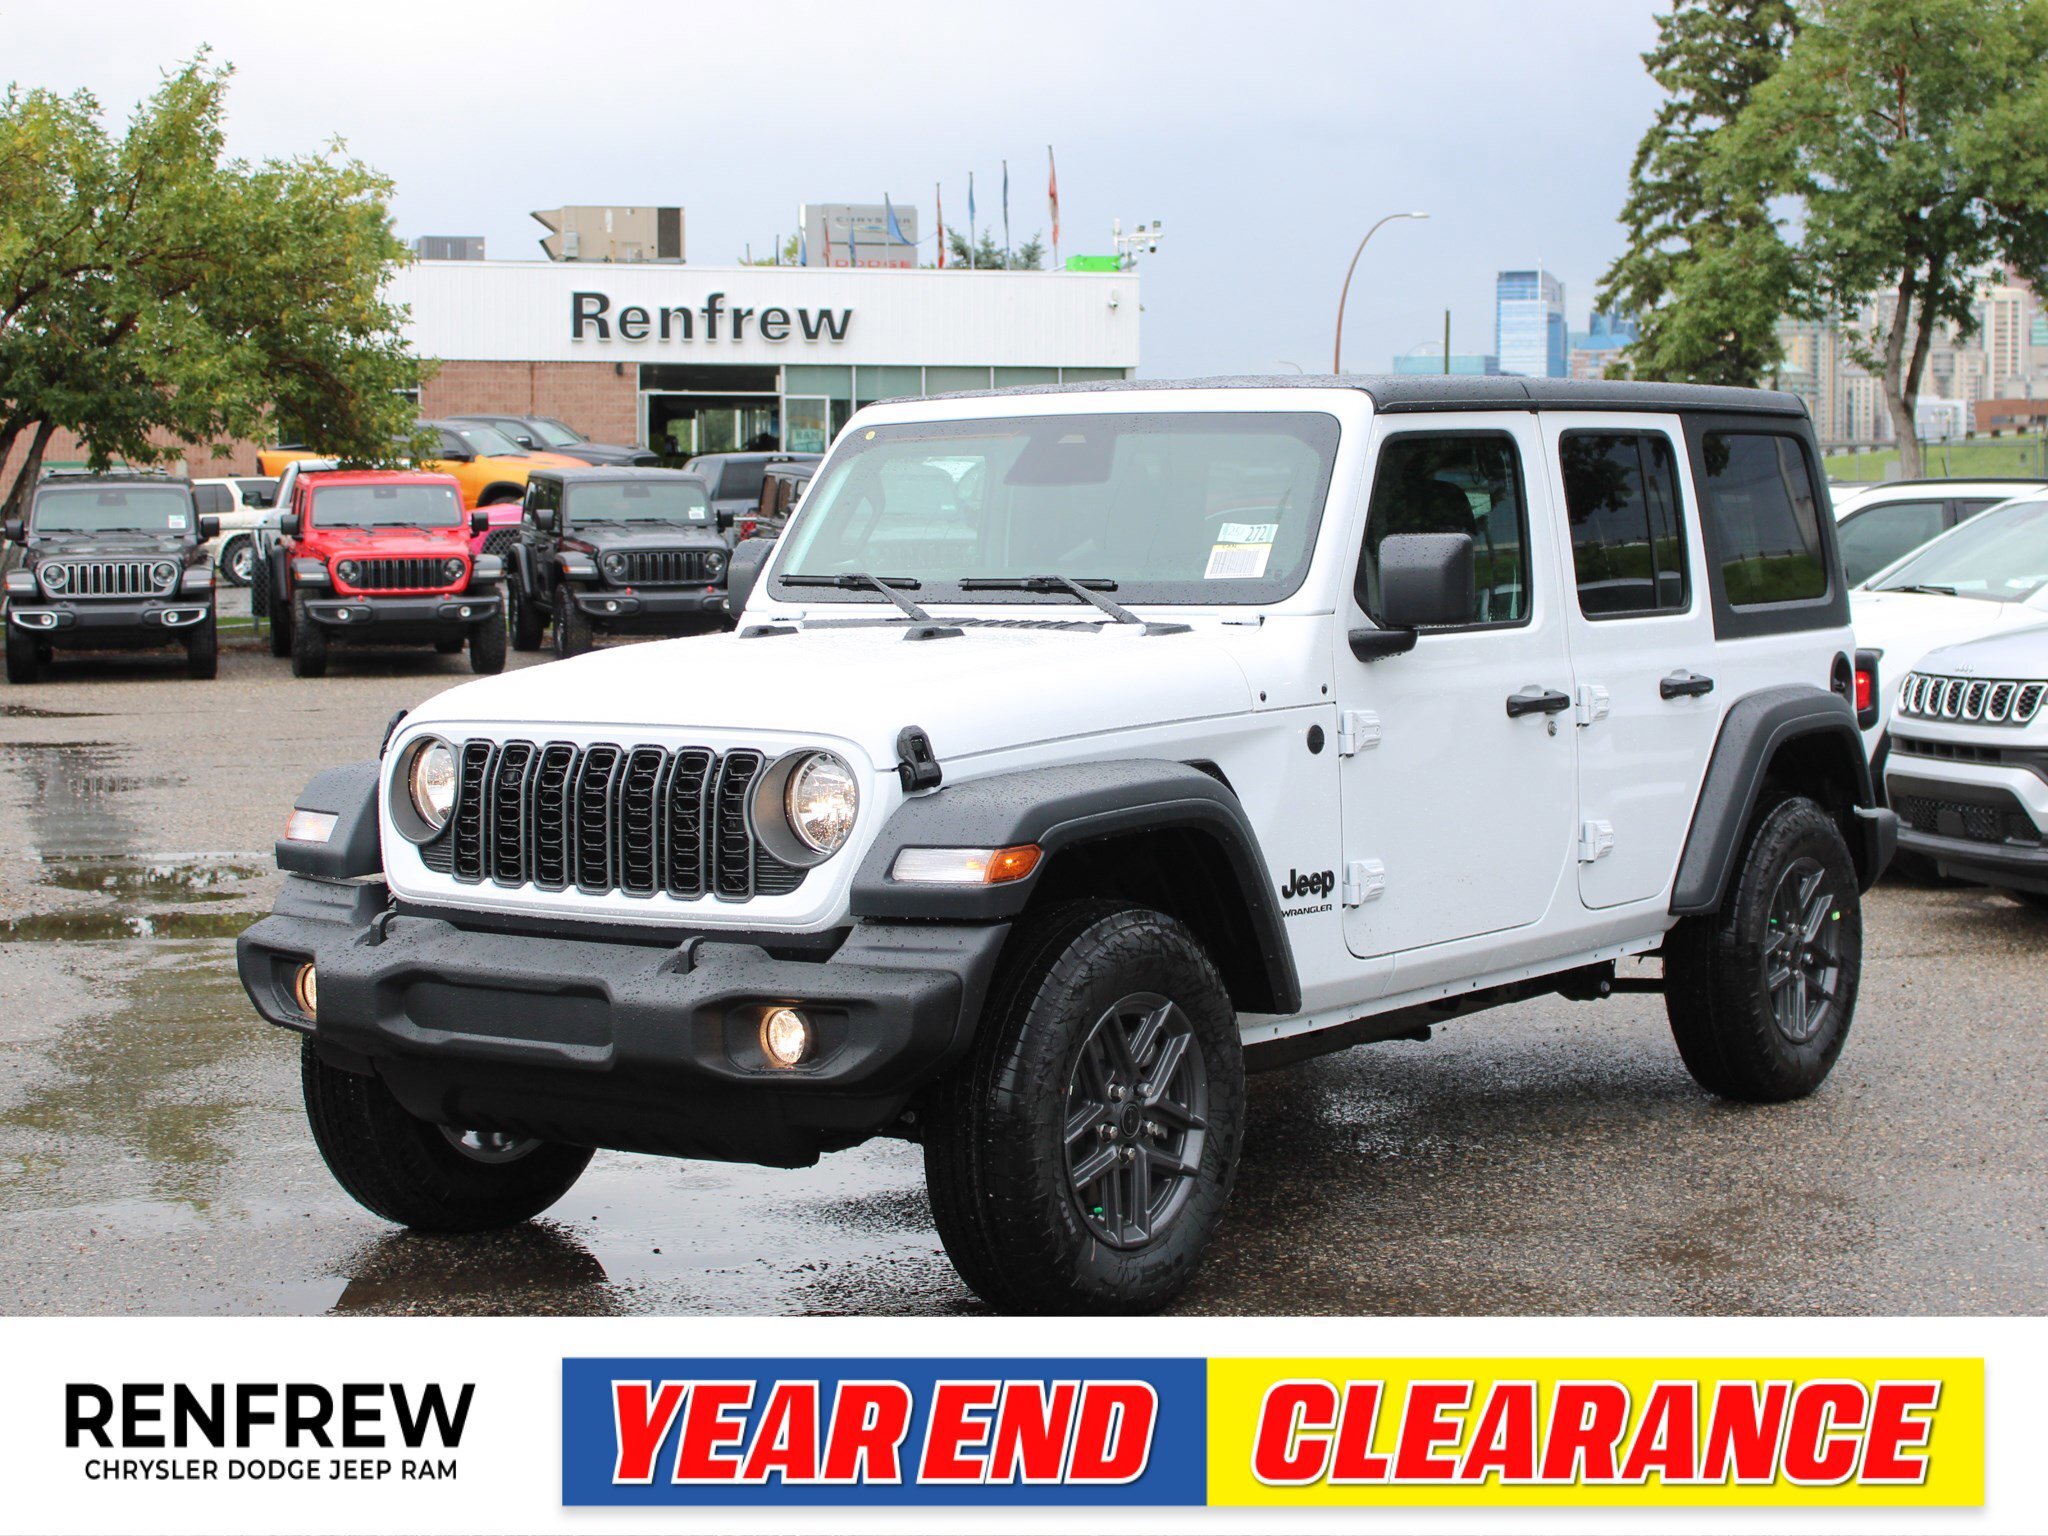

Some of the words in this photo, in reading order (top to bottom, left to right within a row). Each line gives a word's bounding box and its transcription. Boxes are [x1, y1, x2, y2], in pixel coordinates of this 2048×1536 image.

[573, 291, 853, 341] Renfrew
[1281, 868, 1335, 899] Jeep
[1281, 904, 1332, 918] WRANGLER
